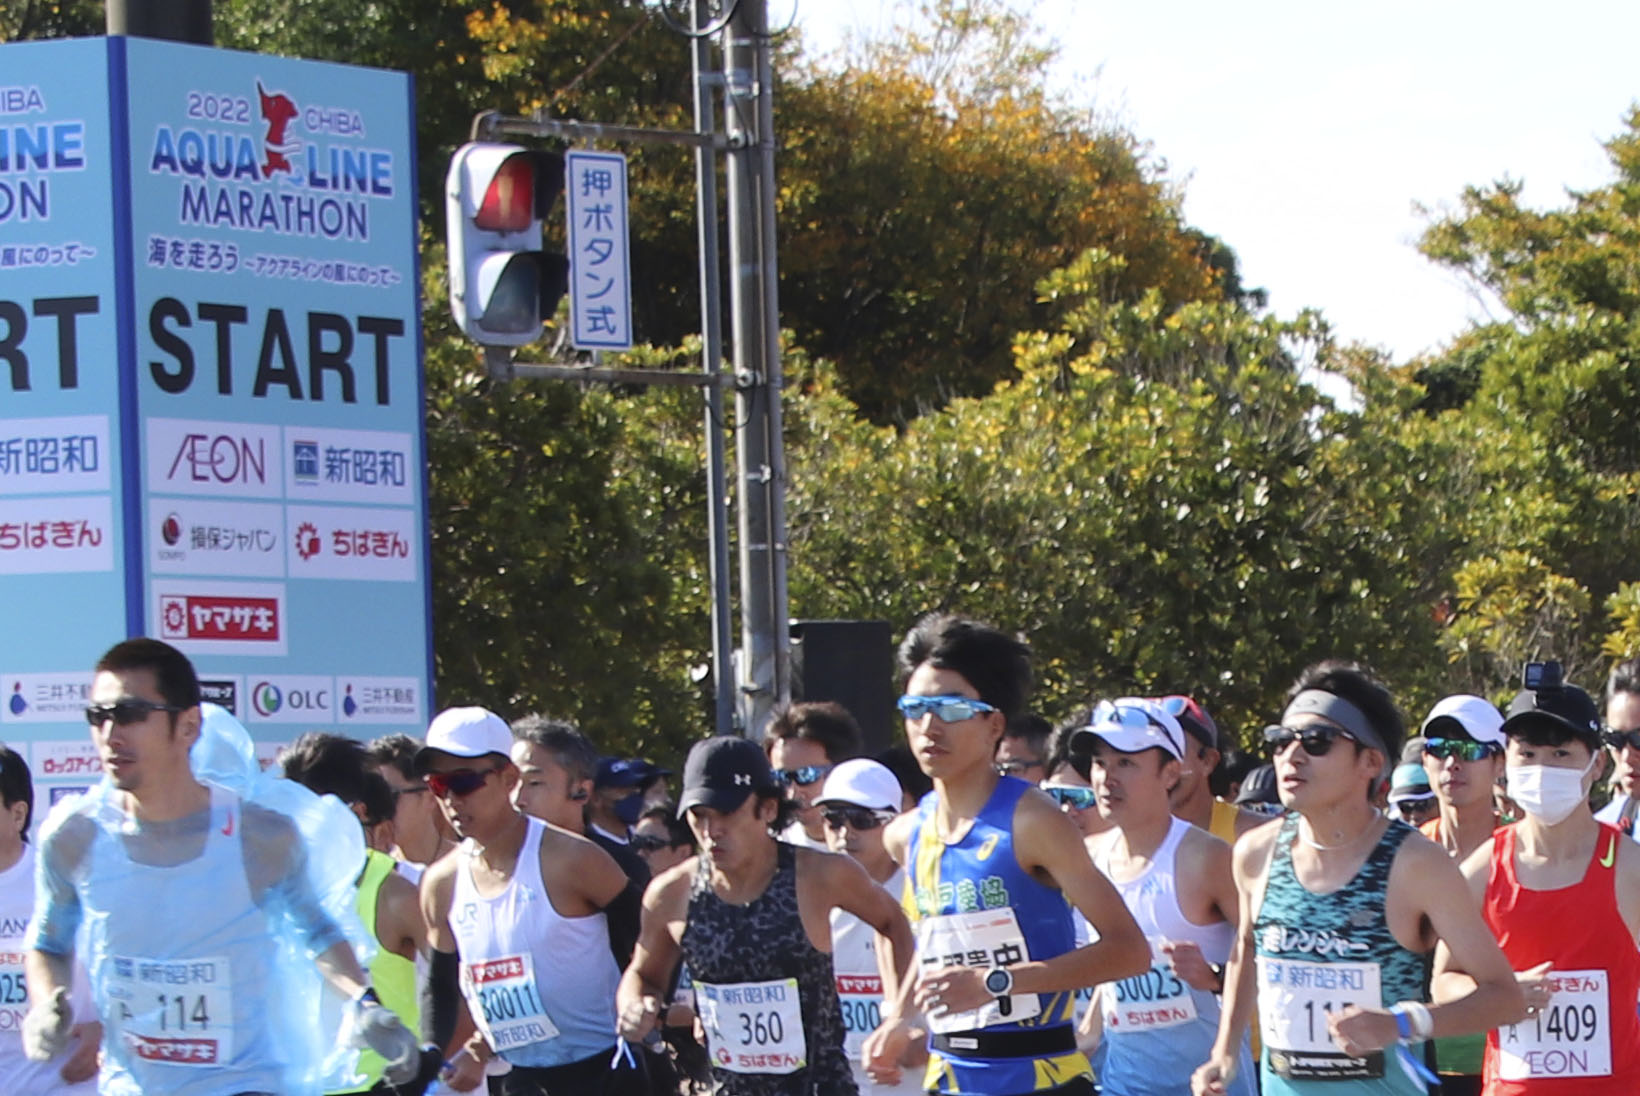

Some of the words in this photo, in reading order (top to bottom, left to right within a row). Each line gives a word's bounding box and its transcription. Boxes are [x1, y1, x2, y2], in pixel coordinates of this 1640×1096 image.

[188, 92, 249, 123] 2022
[304, 108, 364, 135] CHIBA
[151, 127, 261, 182] AQUA
[307, 145, 393, 197] LINE
[181, 183, 367, 239] MARATHON
[149, 237, 239, 271] 海を走ろう
[582, 169, 617, 336] 押ボタン式
[148, 296, 405, 406] START
[325, 446, 405, 487] 新昭和
[190, 526, 276, 552] 損保ジャパン
[333, 529, 409, 559] ちばぎん
[192, 605, 275, 633] ヤマザキ
[288, 690, 329, 710] OLC
[0, 973, 28, 1004] 25
[721, 985, 786, 1005] 新昭和
[1289, 966, 1364, 990] 新昭和
[158, 994, 210, 1031] 114
[479, 981, 539, 1022] 30011
[738, 1010, 784, 1046] 360
[1304, 1000, 1355, 1043] 11
[1536, 1004, 1597, 1042] 1409
[736, 1052, 800, 1068] ちばぎん
